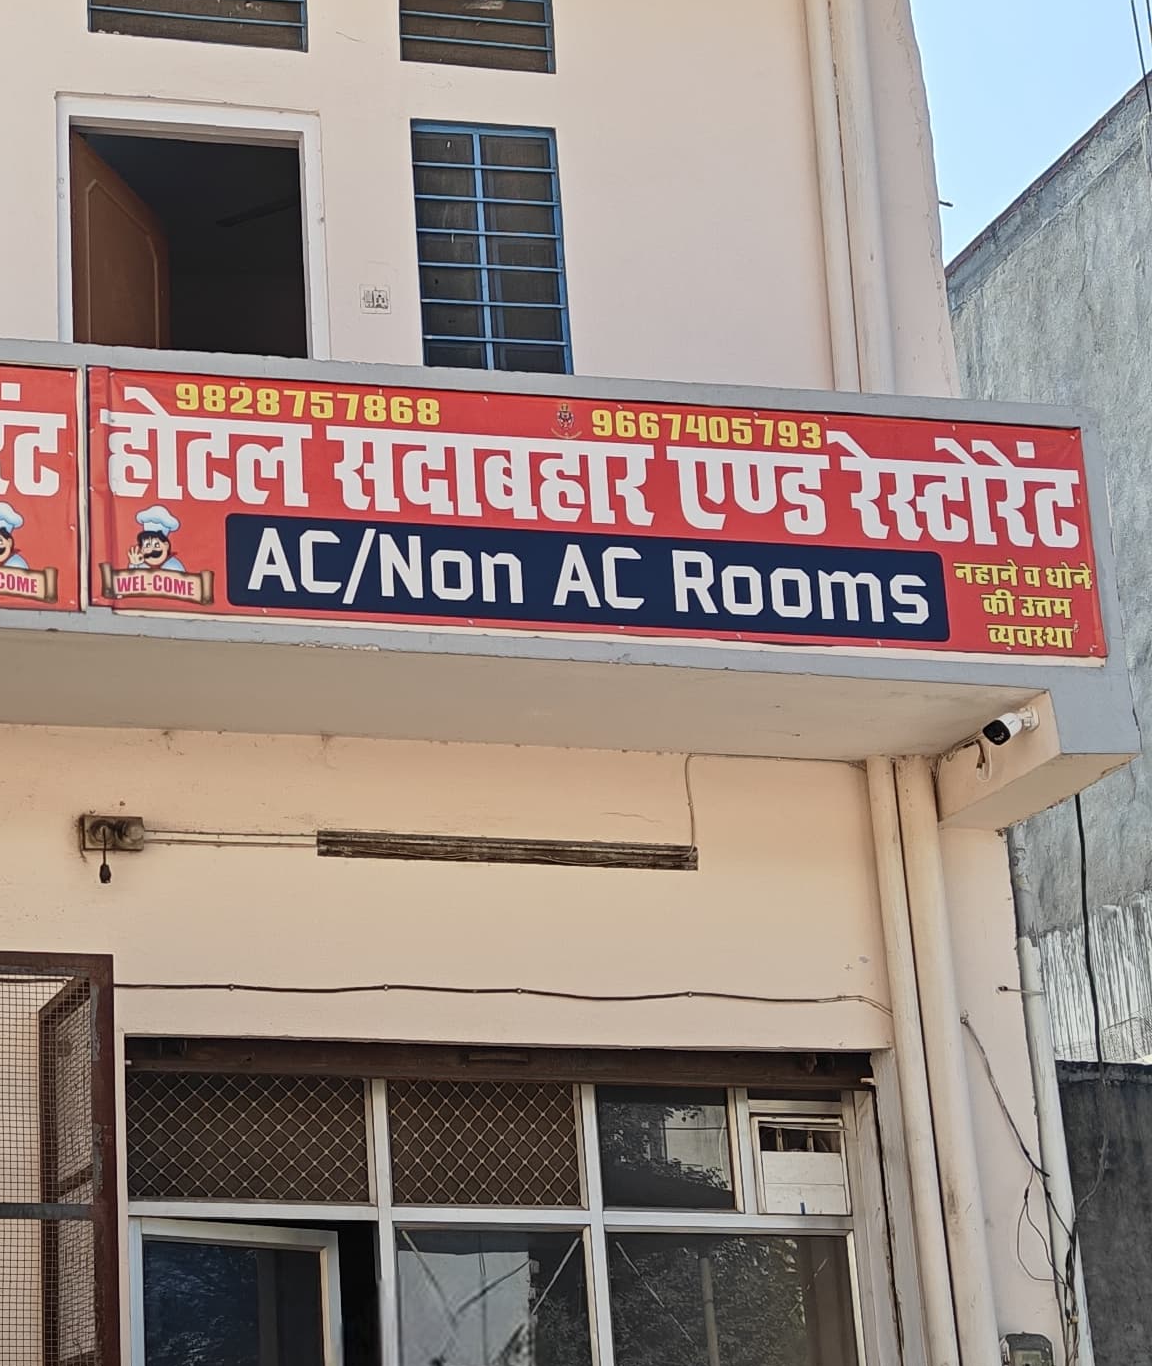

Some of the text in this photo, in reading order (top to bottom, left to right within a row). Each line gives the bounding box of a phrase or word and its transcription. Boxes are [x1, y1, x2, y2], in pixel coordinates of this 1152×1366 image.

[175, 382, 441, 426] 9828757868
[591, 409, 822, 449] 9667405793
[100, 386, 1080, 549] होटल सदाबहार एण्ड रेस्टोरेंट
[116, 574, 195, 597] WEL-COME
[247, 526, 930, 625] AC/Non AC Rooms
[953, 559, 1092, 589] नहाने व धोने
[980, 589, 1072, 619] की उत्तम
[986, 624, 1074, 649] व्यवस्था
